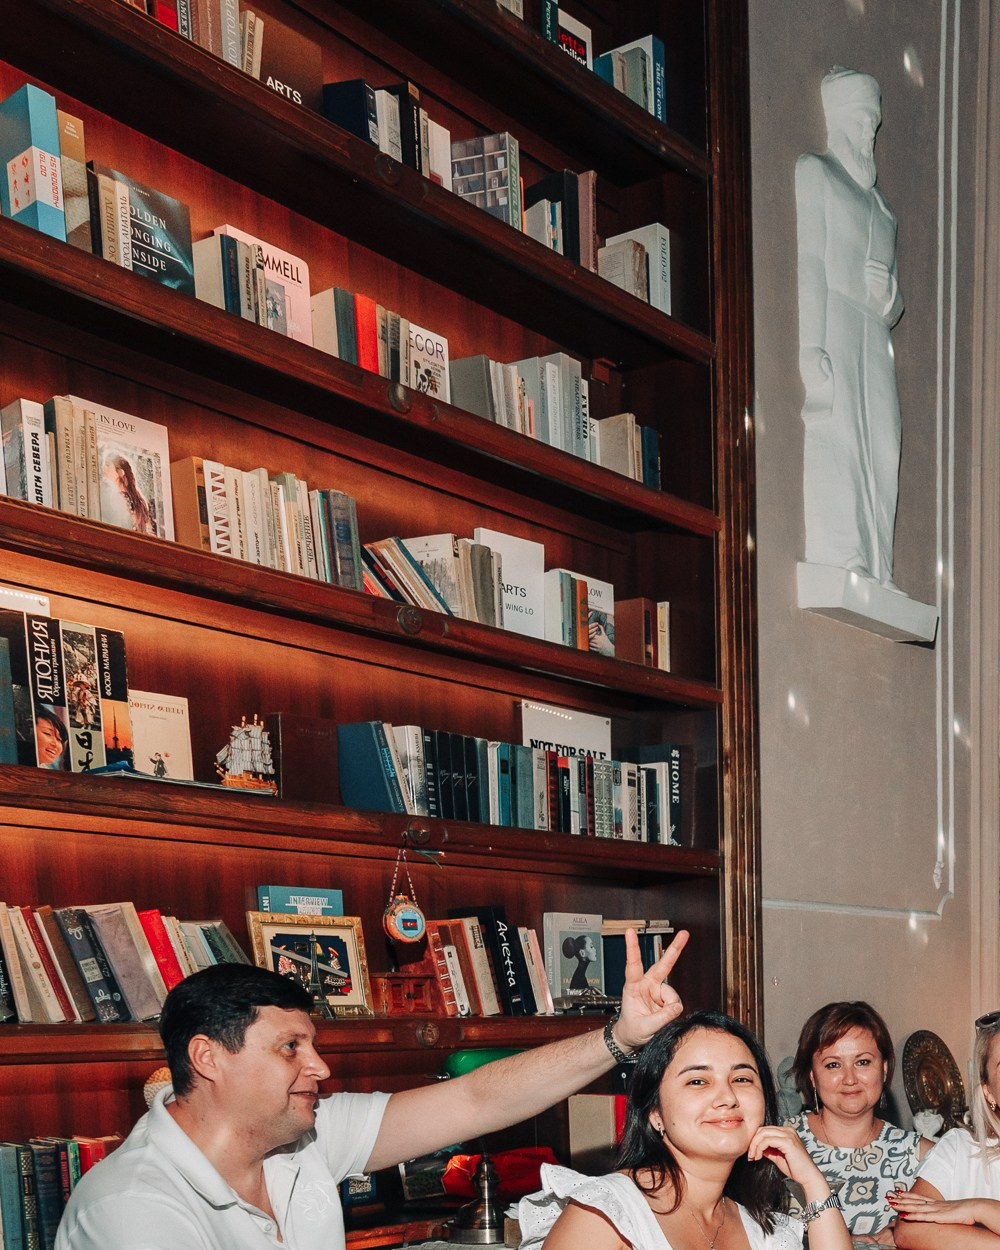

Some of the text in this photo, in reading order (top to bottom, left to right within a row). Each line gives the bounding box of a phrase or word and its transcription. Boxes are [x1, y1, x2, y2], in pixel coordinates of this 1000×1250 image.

[181, 0, 189, 29] ЖЕМЧ
[225, 10, 236, 34] TOP
[266, 76, 302, 105] ARTS
[39, 151, 47, 177] IGLOO
[50, 156, 60, 208] ASTRONOMY
[104, 197, 115, 234] ЛЕНИН
[100, 414, 136, 433] IN LOVE
[31, 432, 41, 473] СЕВЕРА
[303, 515, 313, 563] ЧЕРЧЕНИЕ
[500, 583, 527, 598] ARTS
[505, 602, 534, 615] WING LO
[31, 619, 54, 703] ЯПОНИЯ
[52, 675, 60, 696] Образы
[103, 672, 112, 696] ФОСКО
[530, 738, 606, 760] NOT FOR SALE
[671, 764, 680, 804] HOME
[290, 896, 328, 906] INTERVIEW
[496, 920, 516, 987] Arletta
